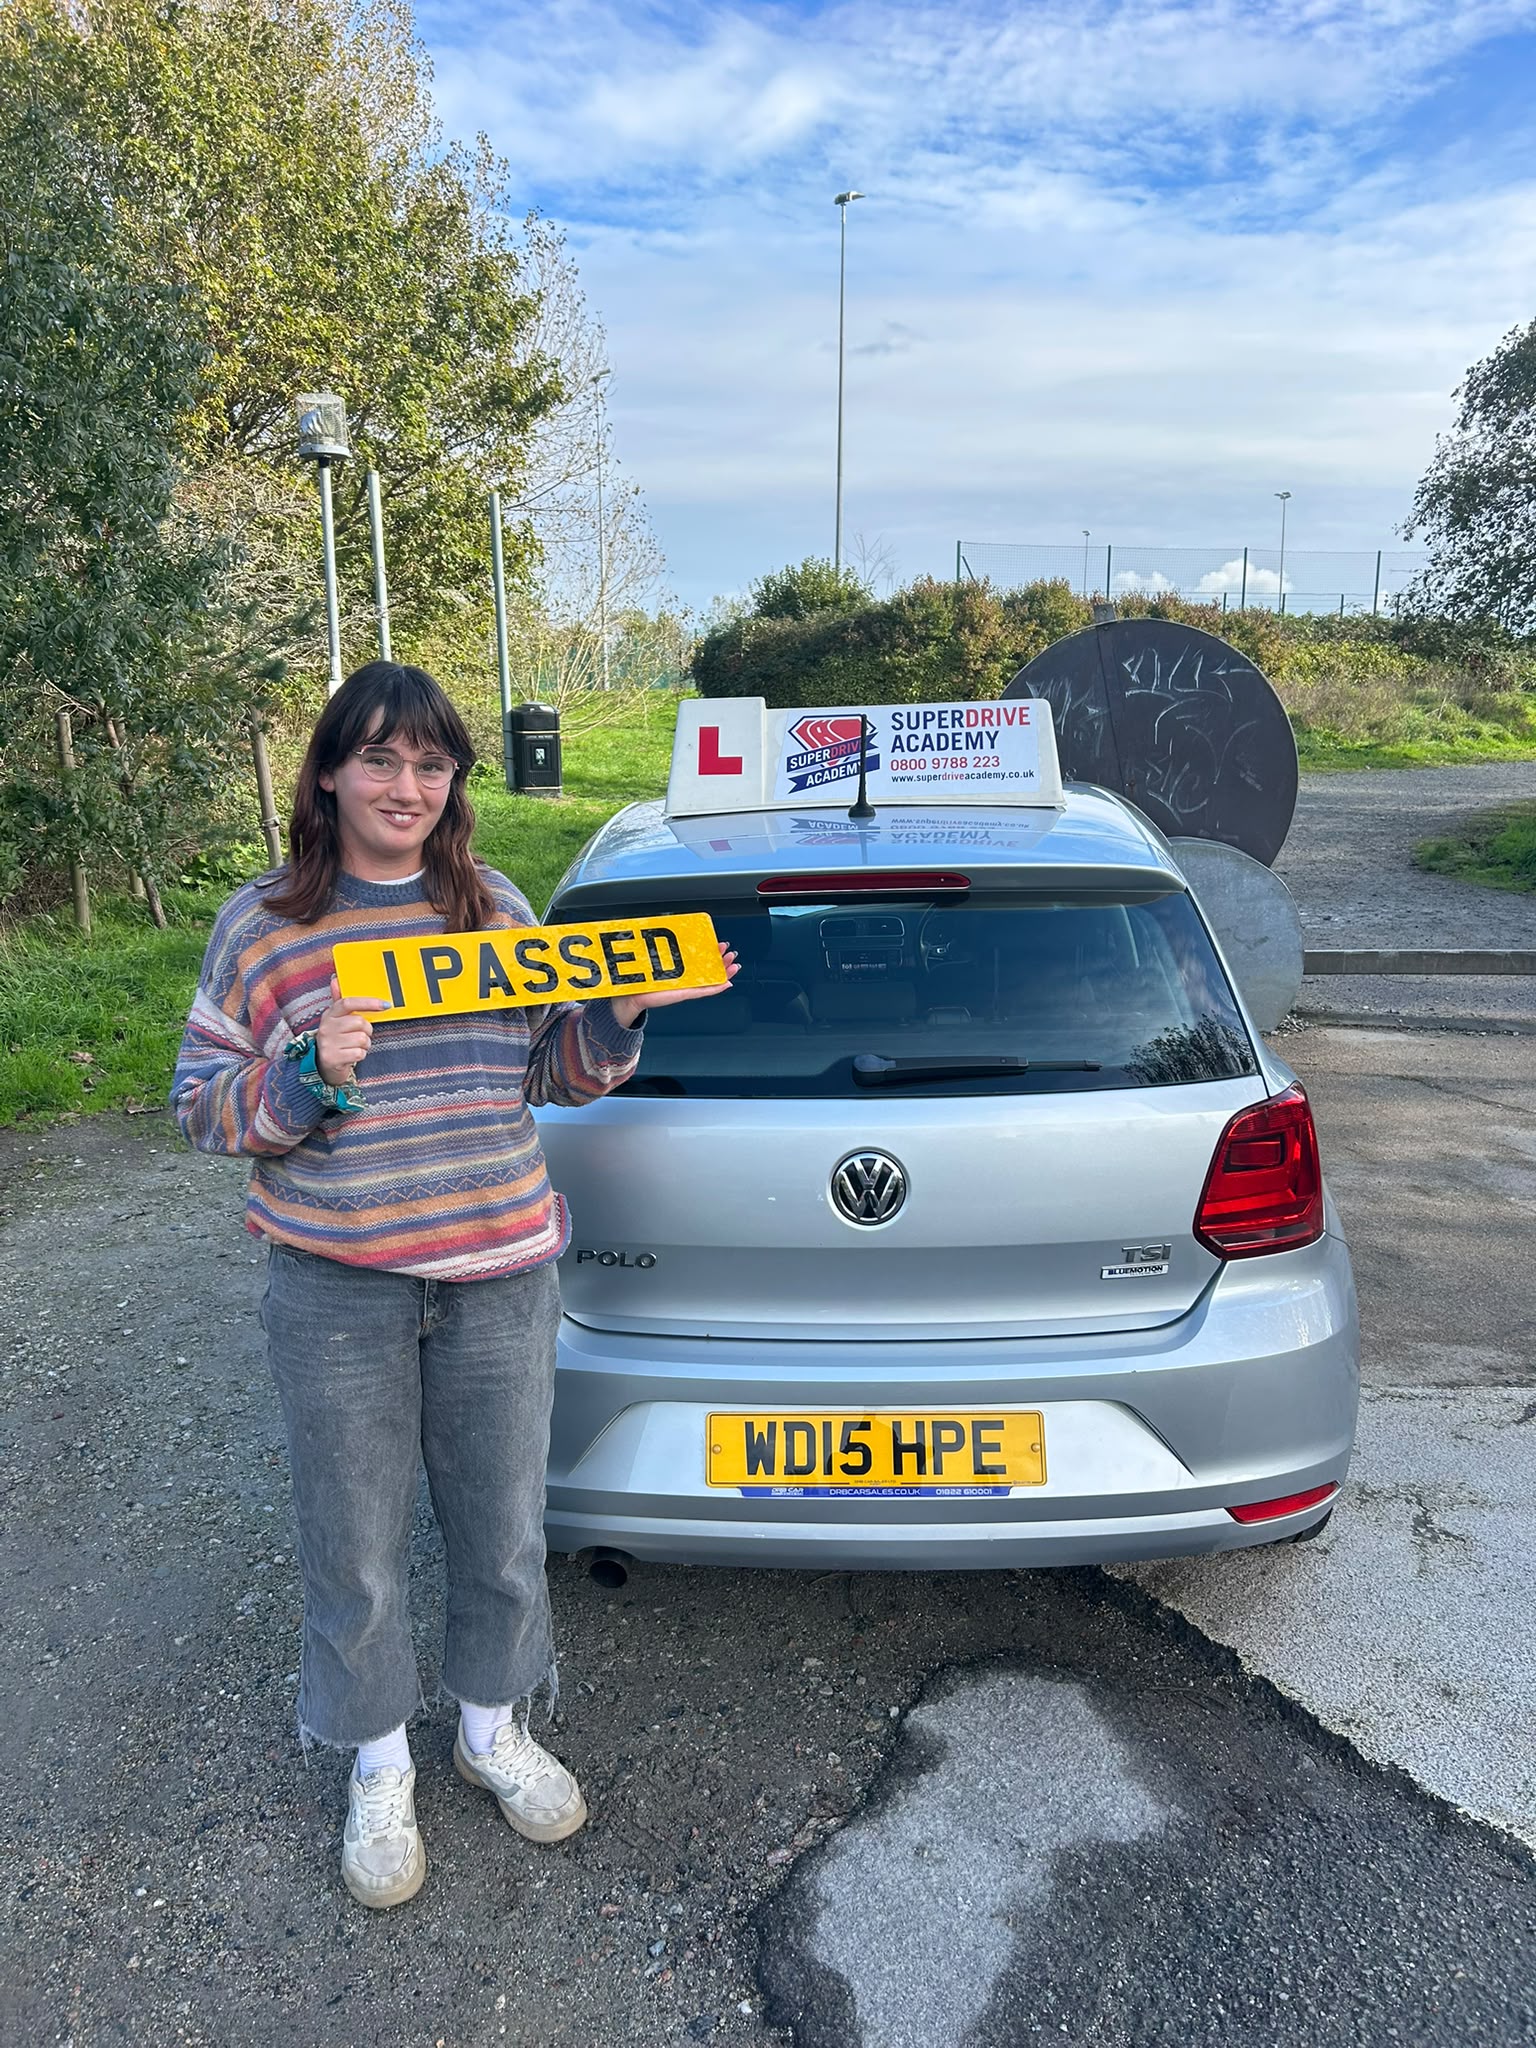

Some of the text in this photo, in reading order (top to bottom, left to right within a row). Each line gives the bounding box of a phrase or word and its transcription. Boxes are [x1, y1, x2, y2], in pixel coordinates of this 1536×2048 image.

[891, 706, 1031, 731] SUPERDRIVE
[698, 726, 742, 775] L
[890, 730, 1000, 753] ACADEMY
[790, 740, 866, 769] SUPERDRIV
[890, 755, 1001, 771] 0800 9788 223
[891, 769, 1035, 783] www.superdriveacademy.co.uk
[382, 927, 686, 1008] I PASSED
[576, 1248, 657, 1269] POLO
[1121, 1243, 1172, 1263] TSI
[1107, 1264, 1163, 1276] BLUEMOTION
[744, 1420, 1007, 1476] WD15 HPE
